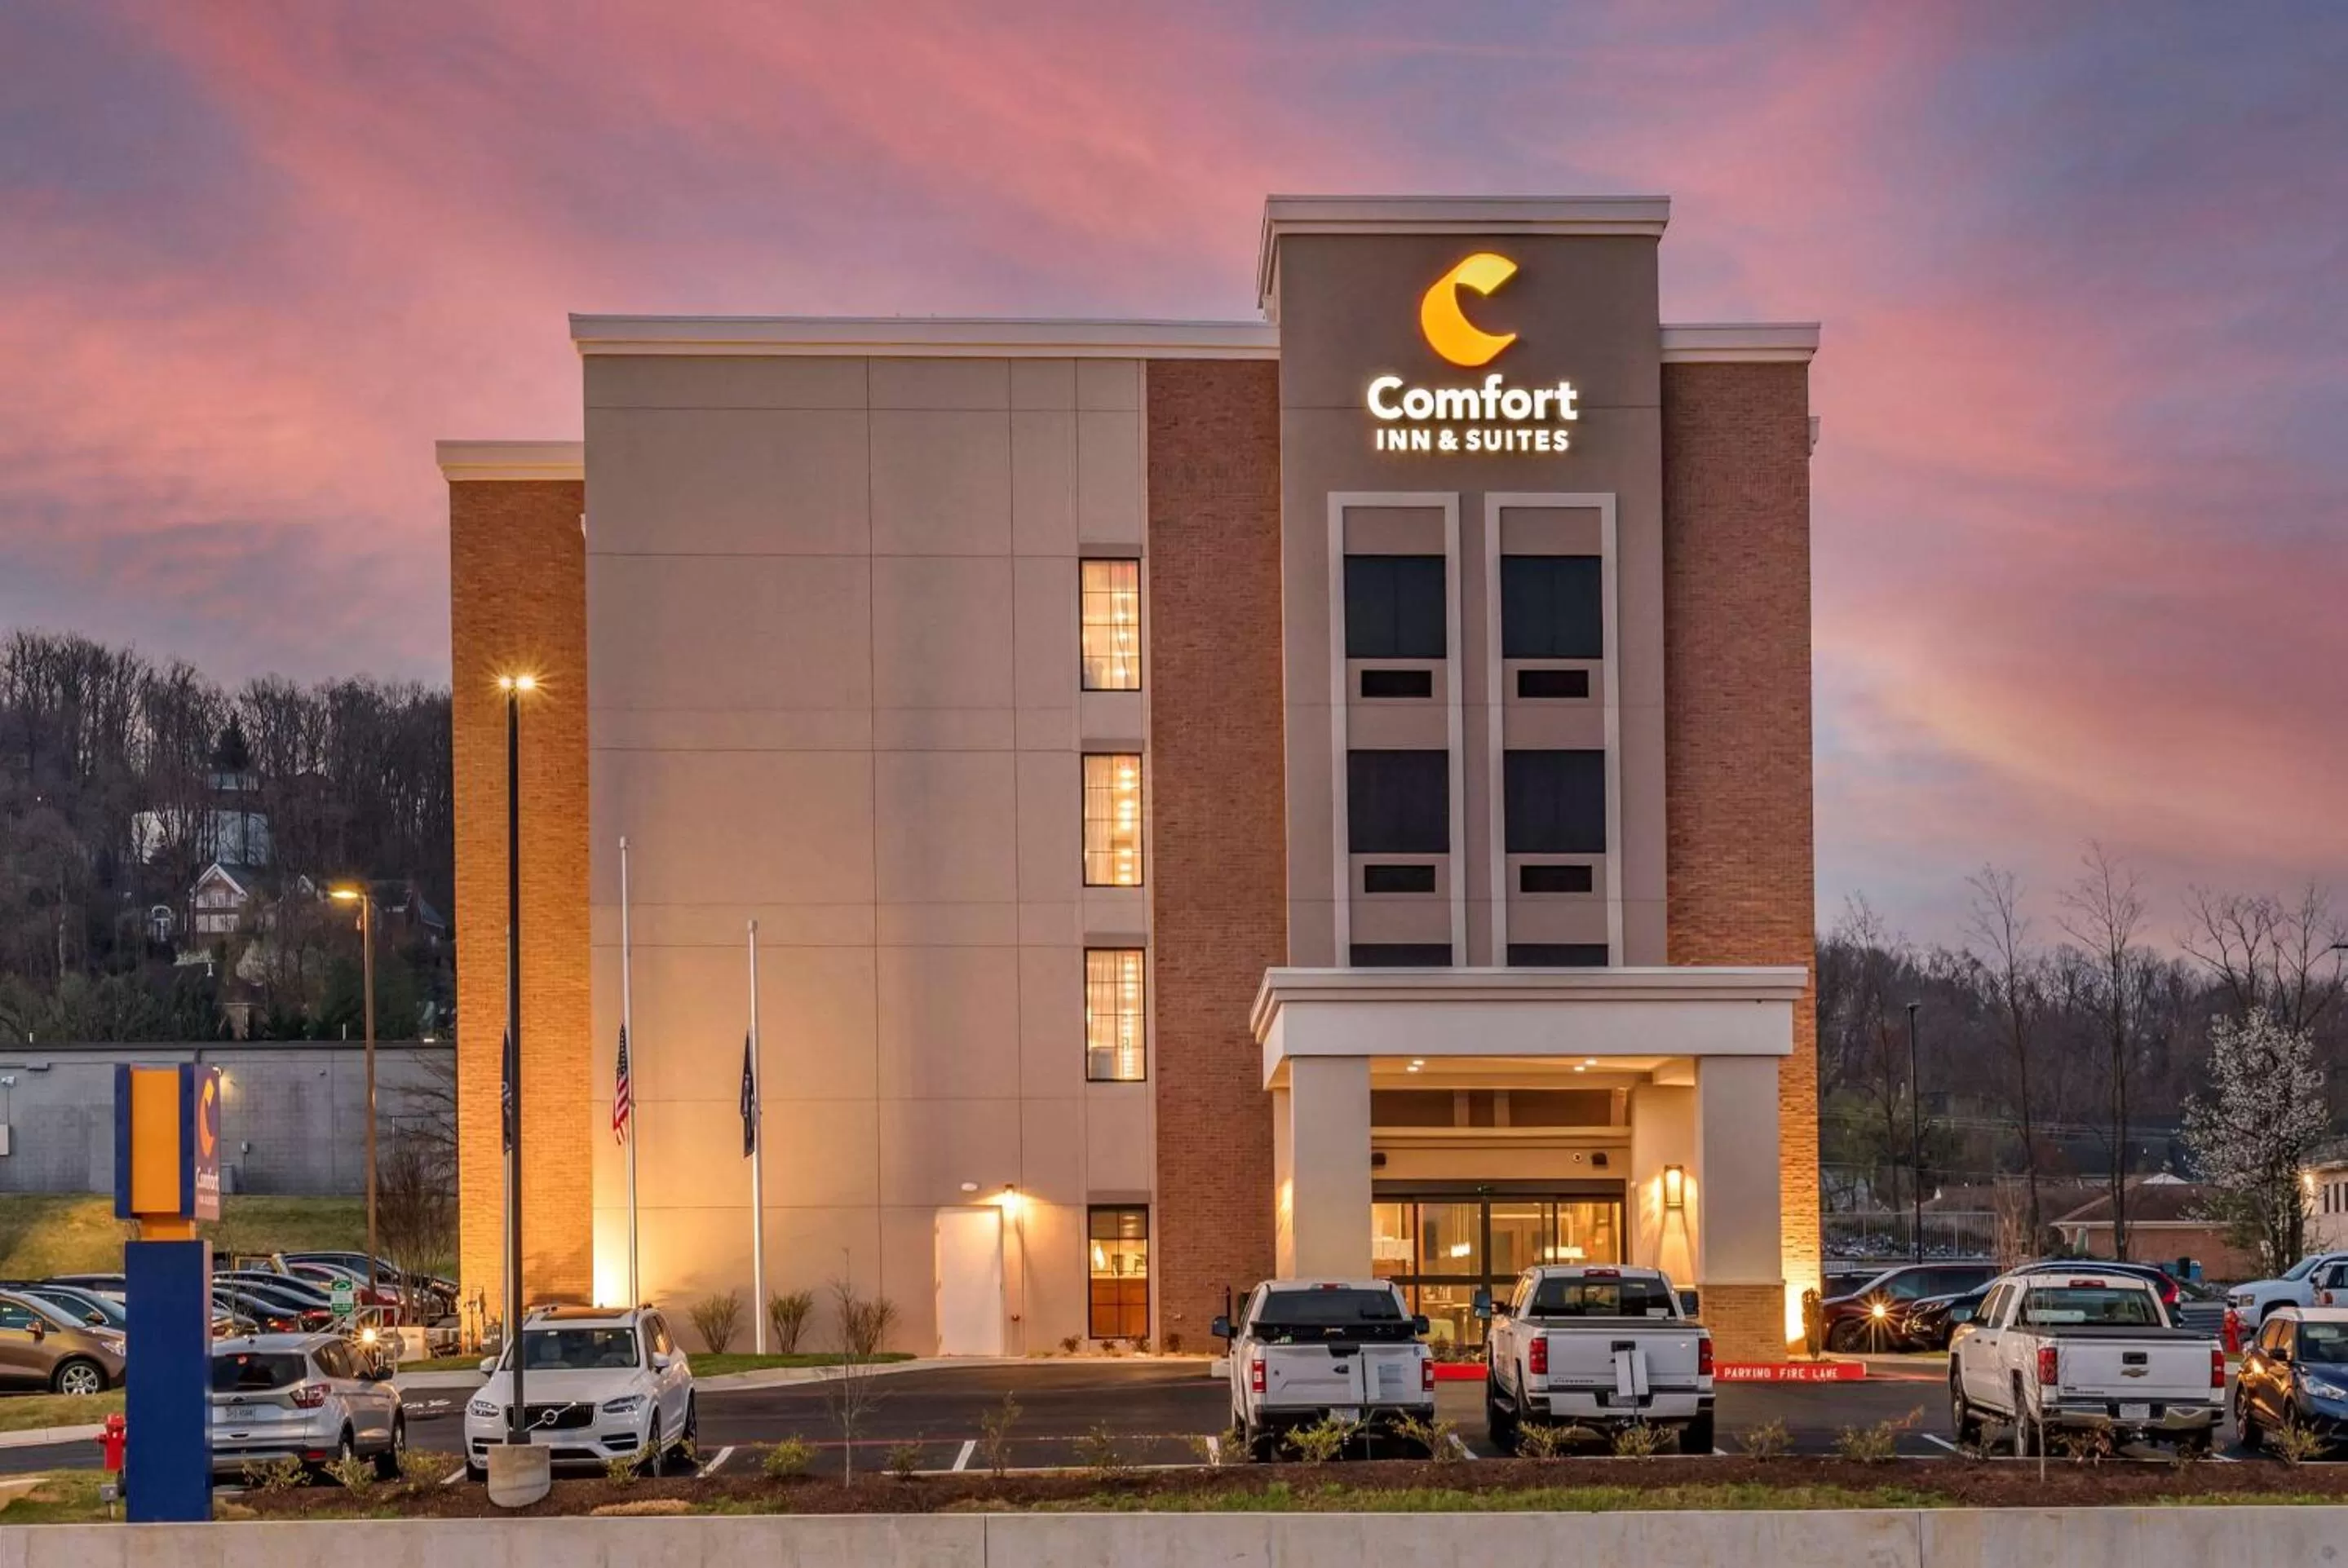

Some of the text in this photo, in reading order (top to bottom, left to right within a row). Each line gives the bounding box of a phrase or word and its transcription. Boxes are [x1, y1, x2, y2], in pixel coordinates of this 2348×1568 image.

[1367, 373, 1578, 421] Comfort
[1377, 429, 1569, 452] INN & SUITES
[1724, 1367, 1771, 1380] PARKING
[1780, 1367, 1805, 1380] FIRE
[1812, 1368, 1837, 1380] LANE
